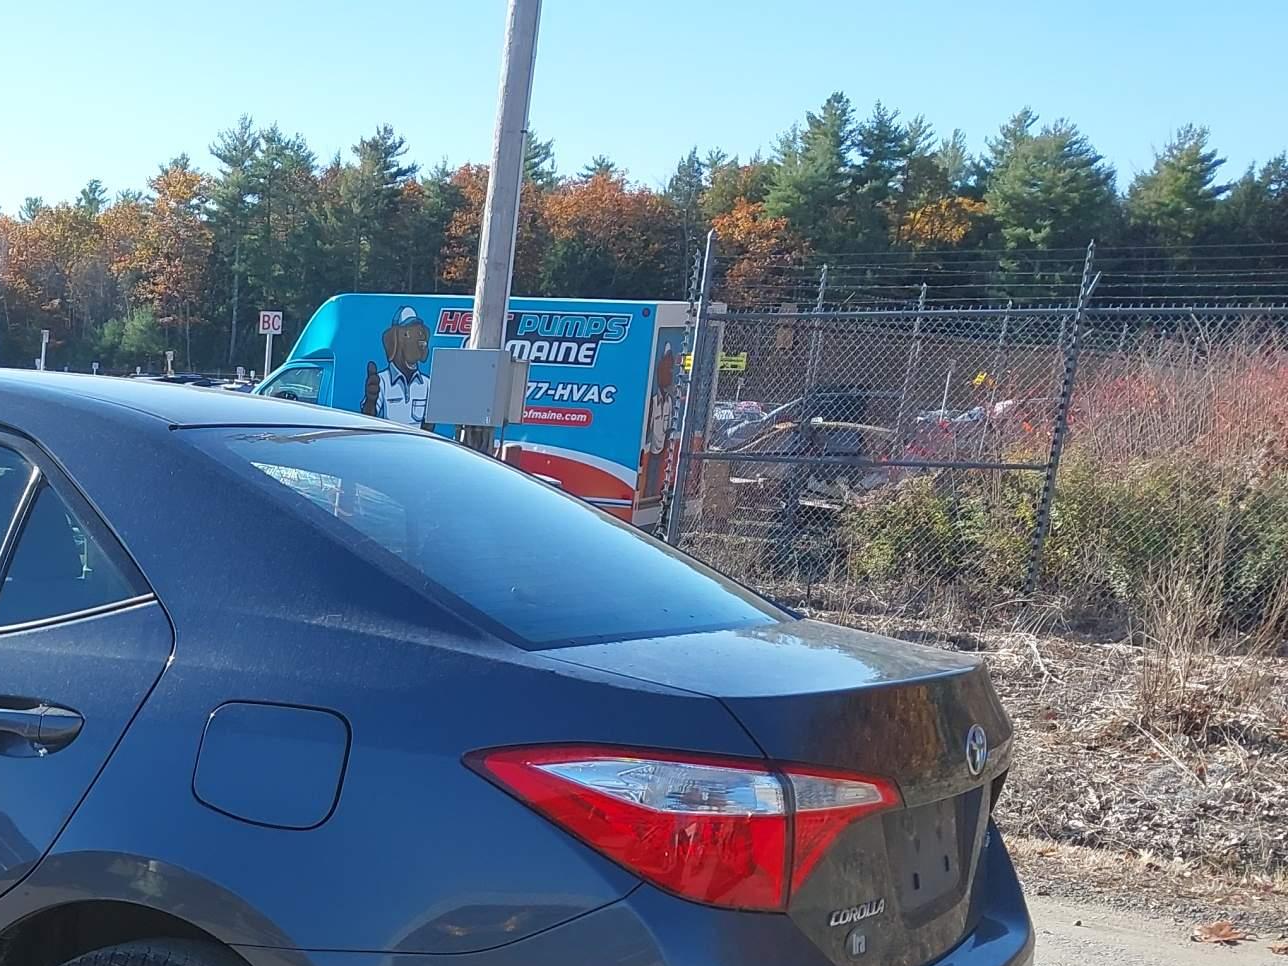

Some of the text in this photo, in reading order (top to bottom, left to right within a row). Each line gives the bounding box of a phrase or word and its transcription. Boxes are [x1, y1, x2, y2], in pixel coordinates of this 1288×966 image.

[262, 314, 281, 331] BC
[439, 311, 628, 338] HE PUMPS
[830, 899, 885, 926] COROLLA
